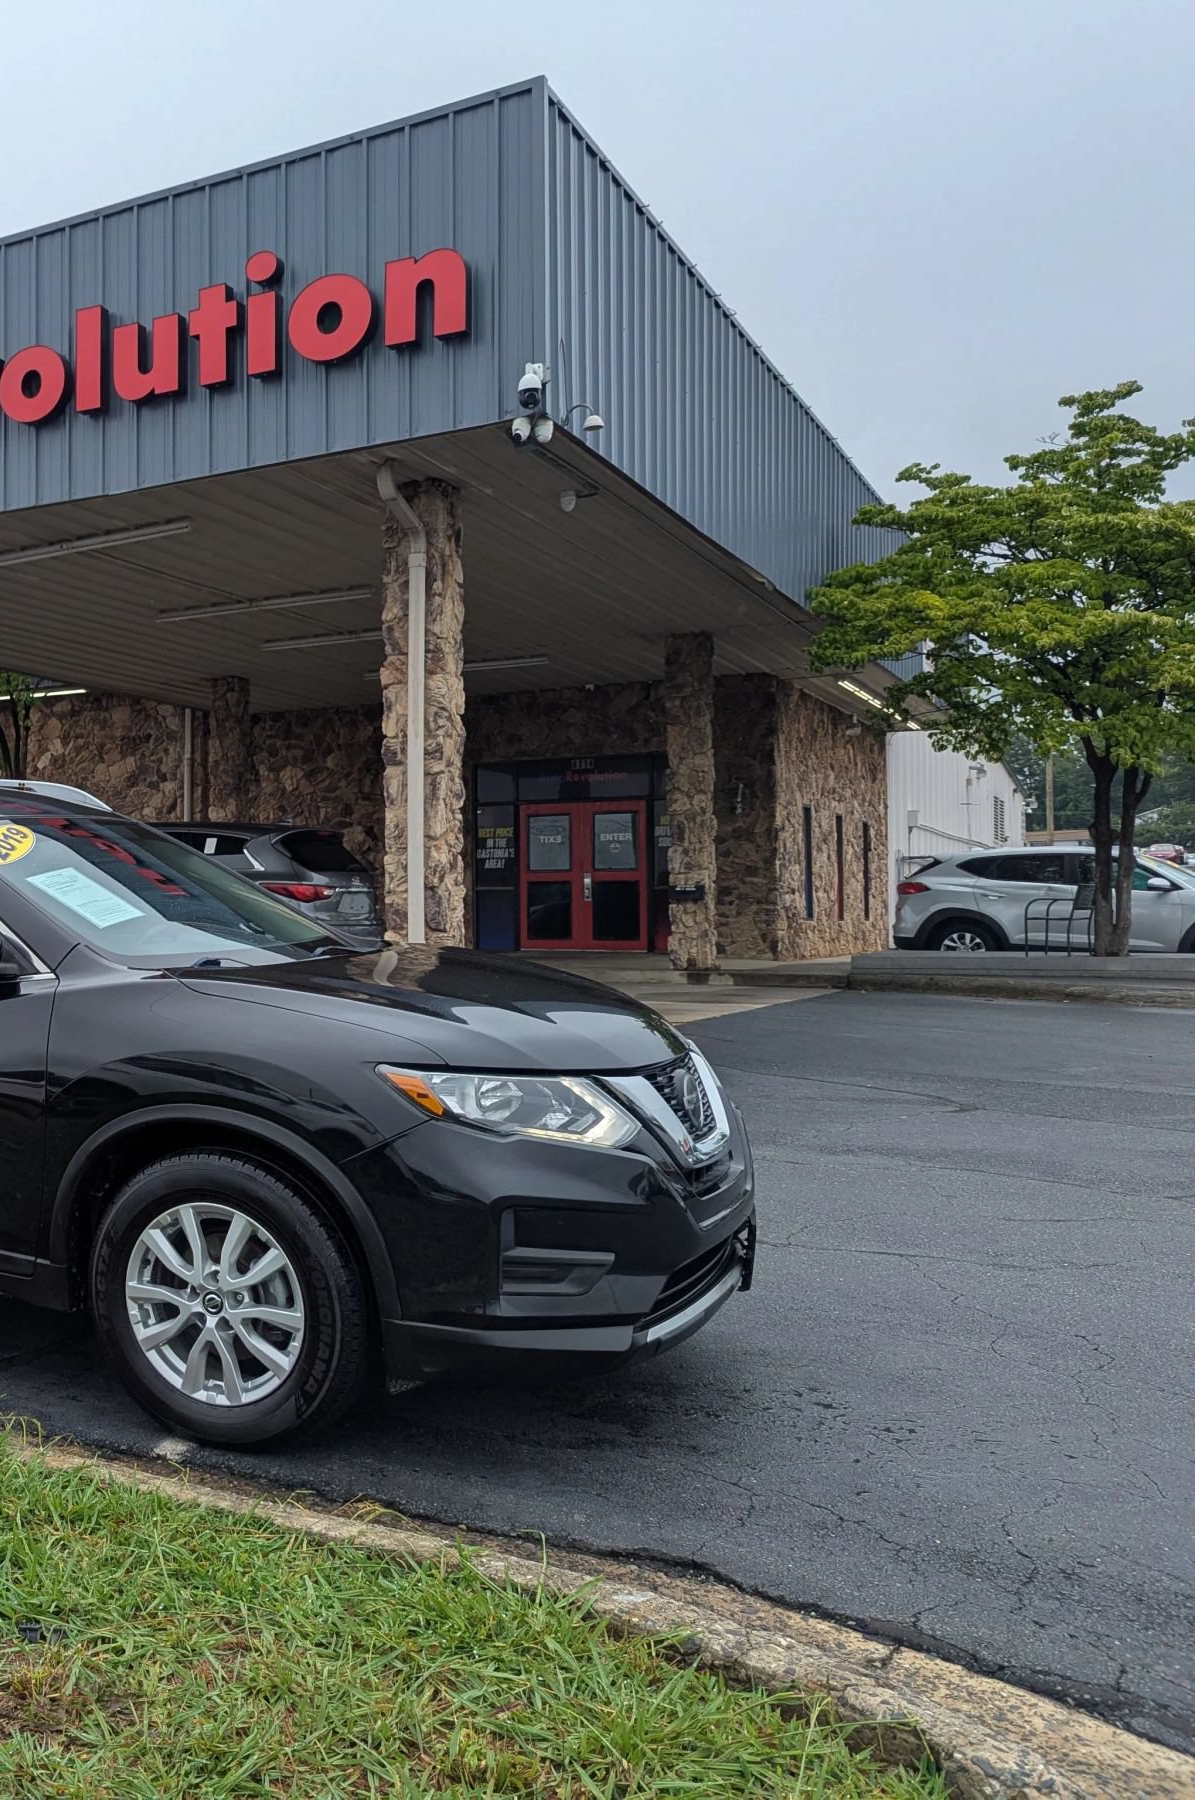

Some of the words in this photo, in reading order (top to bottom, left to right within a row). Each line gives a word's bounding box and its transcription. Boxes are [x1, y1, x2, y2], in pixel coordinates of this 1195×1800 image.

[600, 832, 632, 841] ENTER
[486, 838, 494, 848] IN
[495, 838, 508, 848] THE
